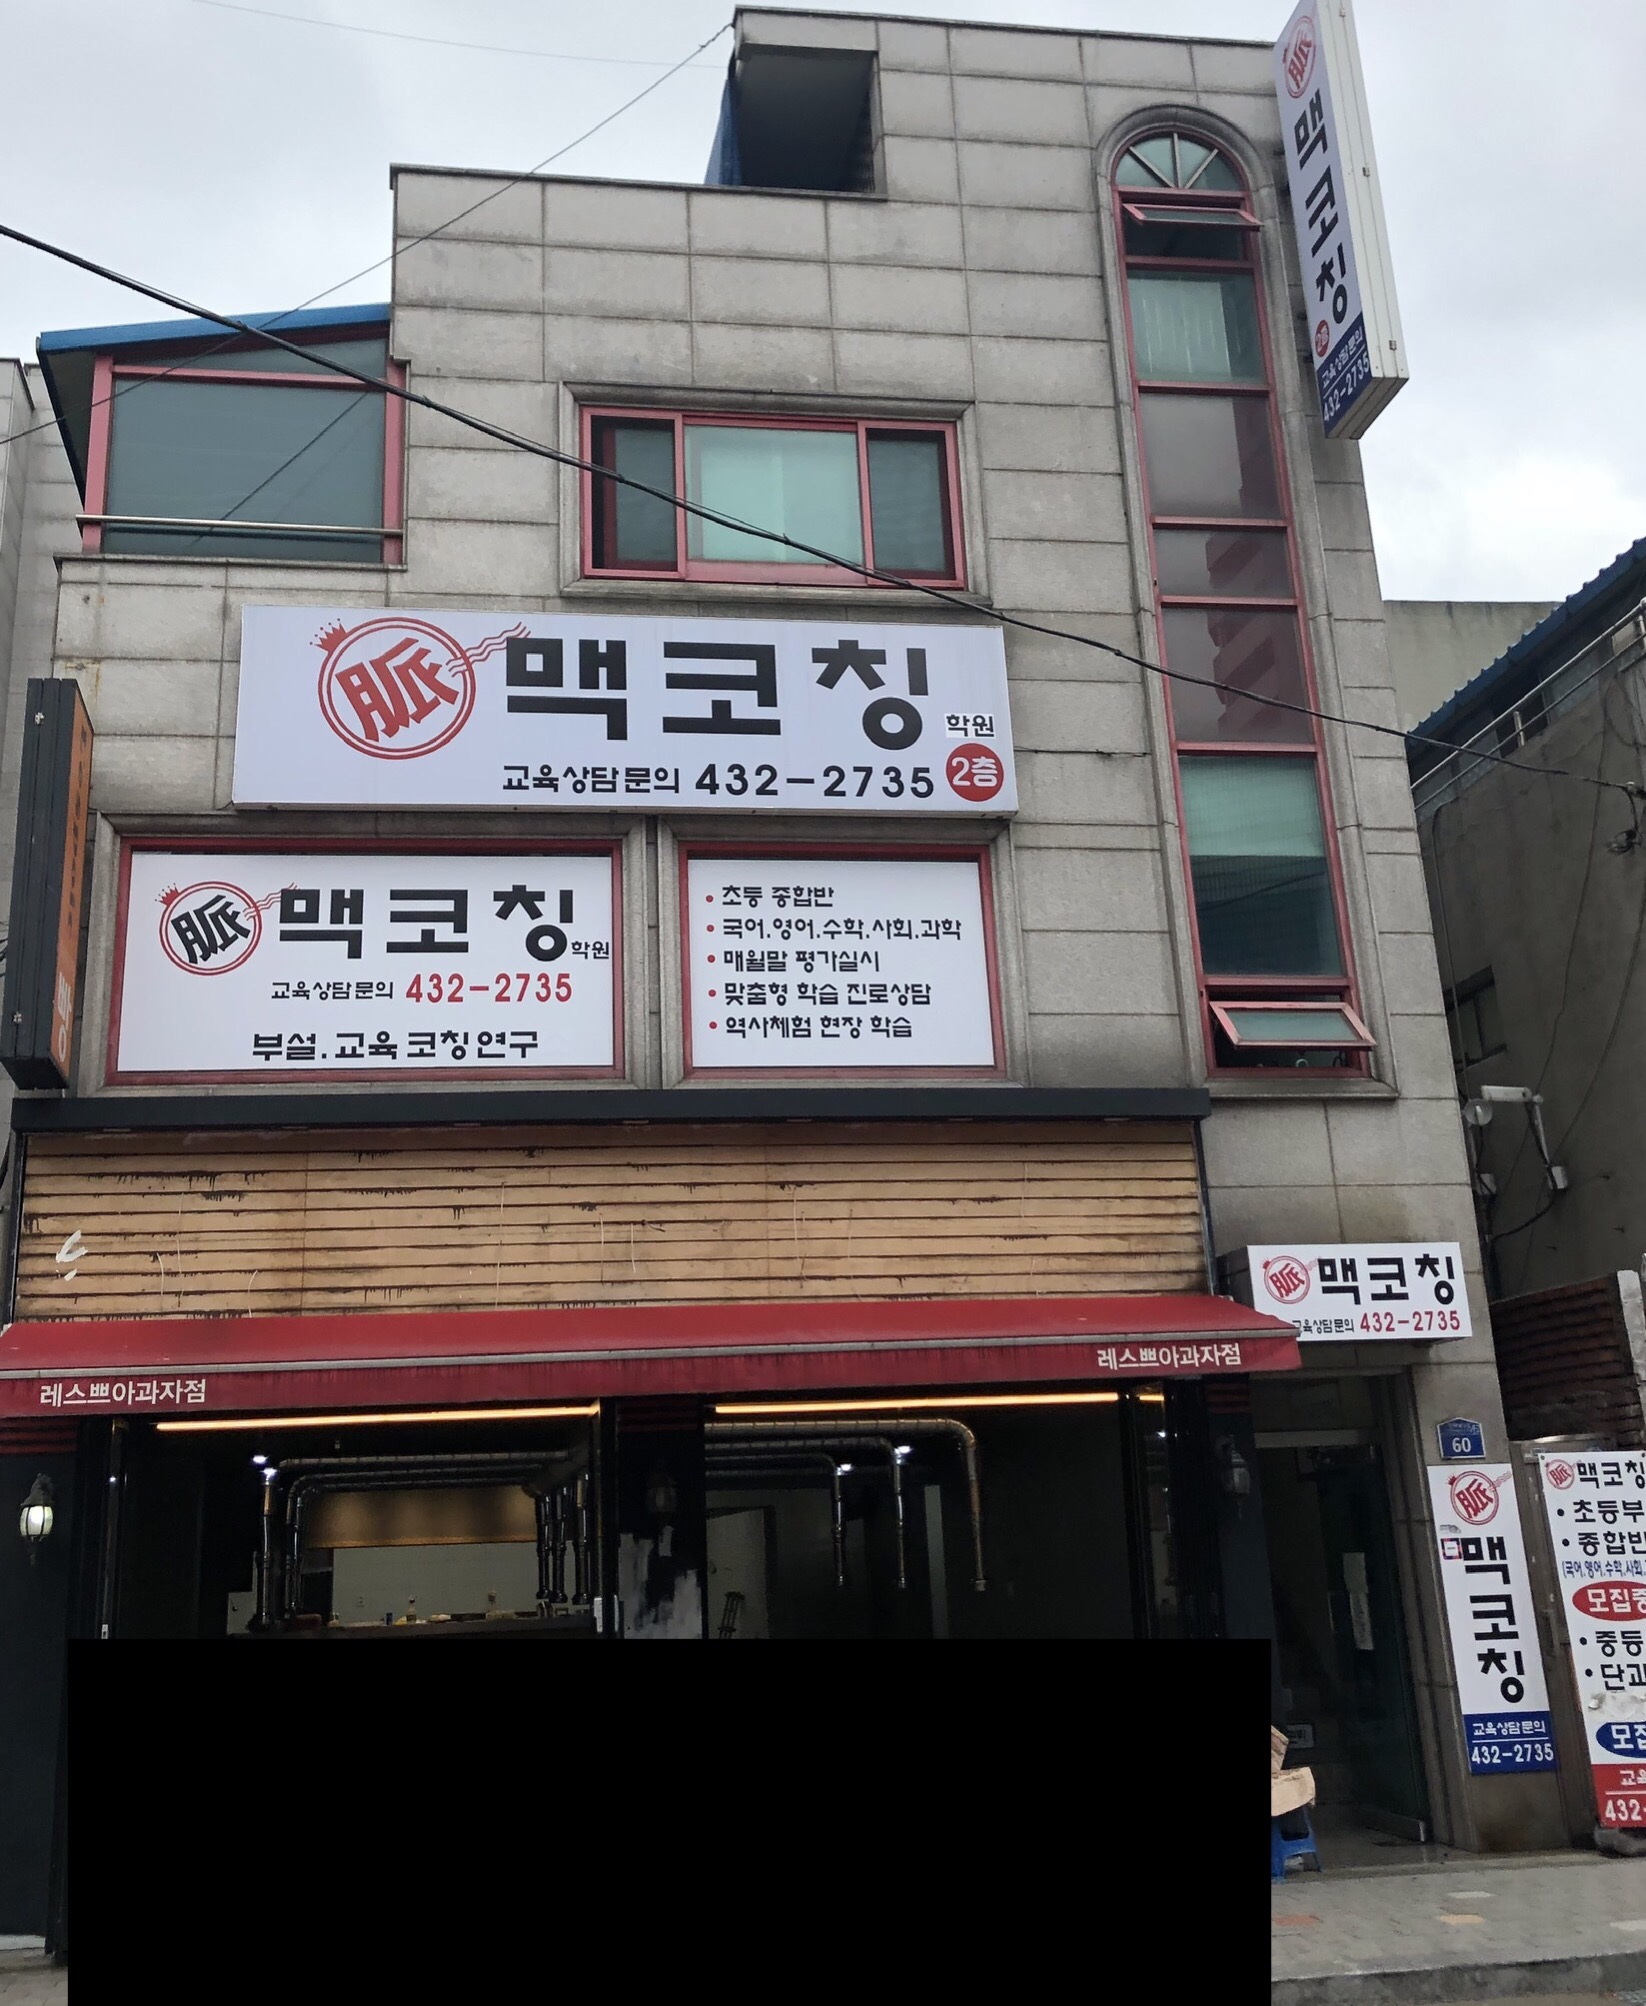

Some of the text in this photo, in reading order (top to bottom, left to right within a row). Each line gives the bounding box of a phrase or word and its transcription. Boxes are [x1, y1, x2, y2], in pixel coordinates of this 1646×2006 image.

[1323, 351, 1370, 422] 432-2735
[500, 630, 994, 750] 맥코칭 학원
[696, 764, 933, 798] 432-2735
[950, 756, 999, 787] 2층
[723, 885, 833, 907] 초등 종합반
[280, 885, 609, 961] 맥코칭 학원
[724, 919, 961, 940] 국어.영어.수학.사회.과학
[724, 950, 879, 973] 매월말 평가실시
[407, 974, 571, 1002] 432-2735
[725, 983, 930, 1006] 맞춤형 학습 진로상담
[727, 1016, 911, 1038] 역사체험 현장 학습
[1318, 1254, 1454, 1305] 맥코칭
[1360, 1311, 1461, 1332] 432-2735
[1098, 1343, 1240, 1369] 레스쁘아과자점
[41, 1379, 205, 1407] 레스쁘아과자점
[1452, 1437, 1472, 1453] 60
[1577, 1460, 1646, 1489] 맥코칭
[1573, 1500, 1644, 1524] 초등부
[1461, 1534, 1526, 1703] 맥코칭
[1472, 1743, 1553, 1763] 432-2735
